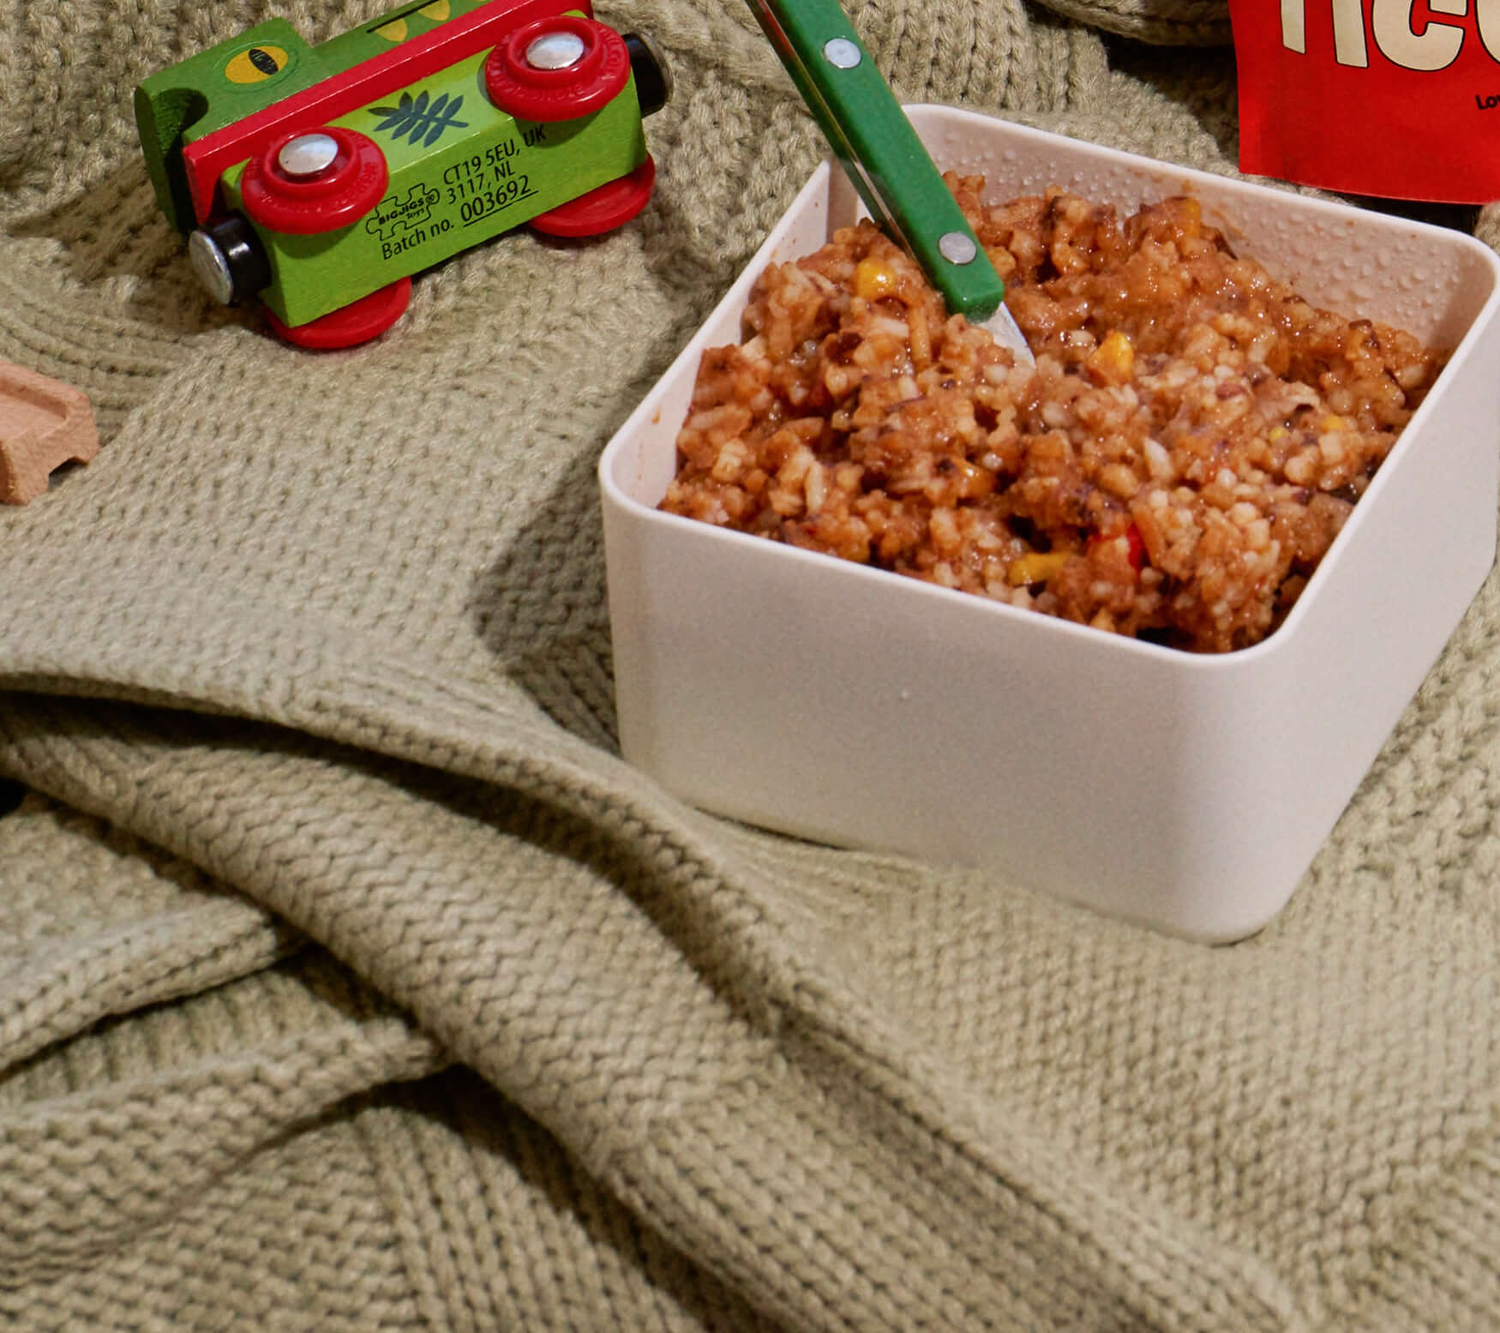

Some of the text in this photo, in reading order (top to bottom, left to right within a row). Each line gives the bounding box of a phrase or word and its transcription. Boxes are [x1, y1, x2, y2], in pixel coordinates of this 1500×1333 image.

[443, 155, 482, 185] CT19
[523, 123, 546, 148] UK
[494, 161, 516, 182] NL
[381, 175, 532, 261] Batch no. 003692
